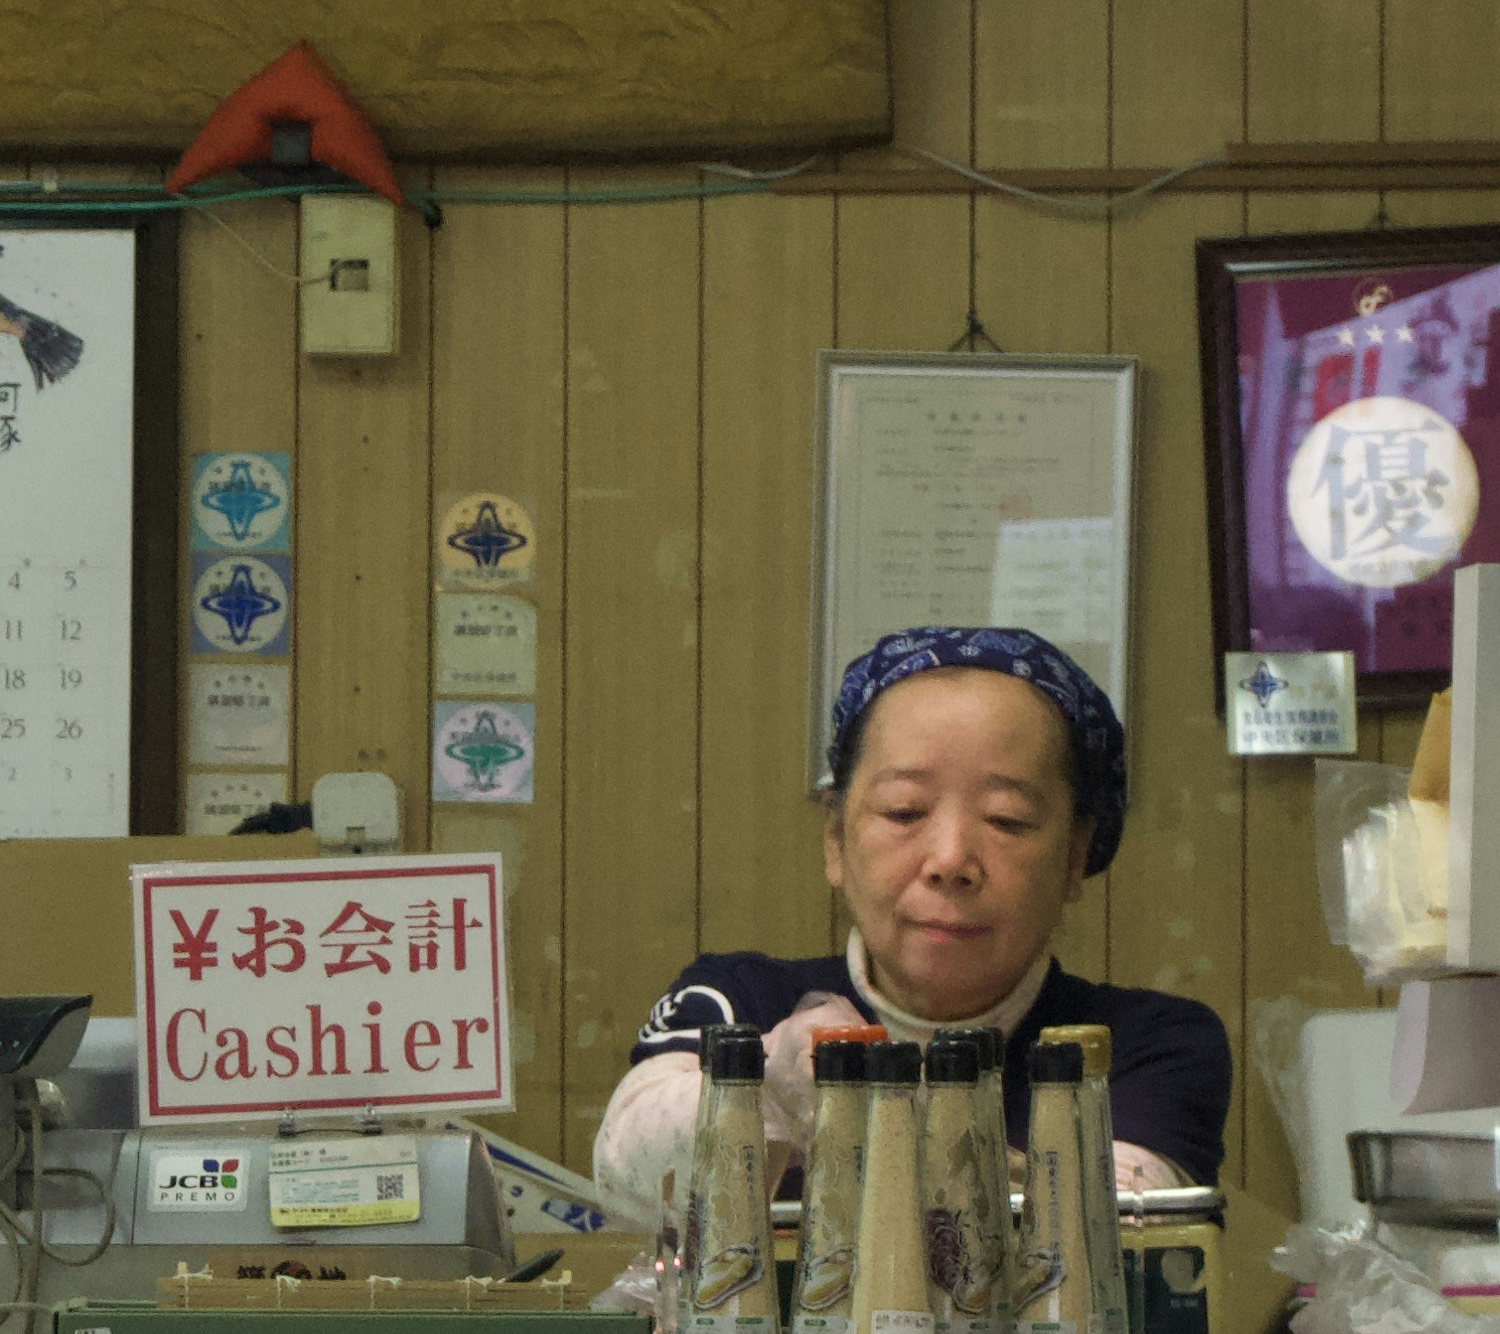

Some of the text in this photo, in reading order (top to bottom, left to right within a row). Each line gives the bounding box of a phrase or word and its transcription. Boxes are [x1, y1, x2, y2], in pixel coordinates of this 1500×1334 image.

[1311, 421, 1455, 563] 優
[8, 570, 22, 590] 4
[64, 570, 77, 590] 5
[4, 620, 23, 641] 11
[60, 620, 82, 641] 12
[3, 667, 26, 689] 18
[60, 667, 82, 689] 19
[0, 717, 26, 739] 25
[56, 717, 83, 739] 26
[165, 1000, 491, 1083] Cashier
[159, 1173, 222, 1190] JCB
[160, 1192, 236, 1202] PREMO
